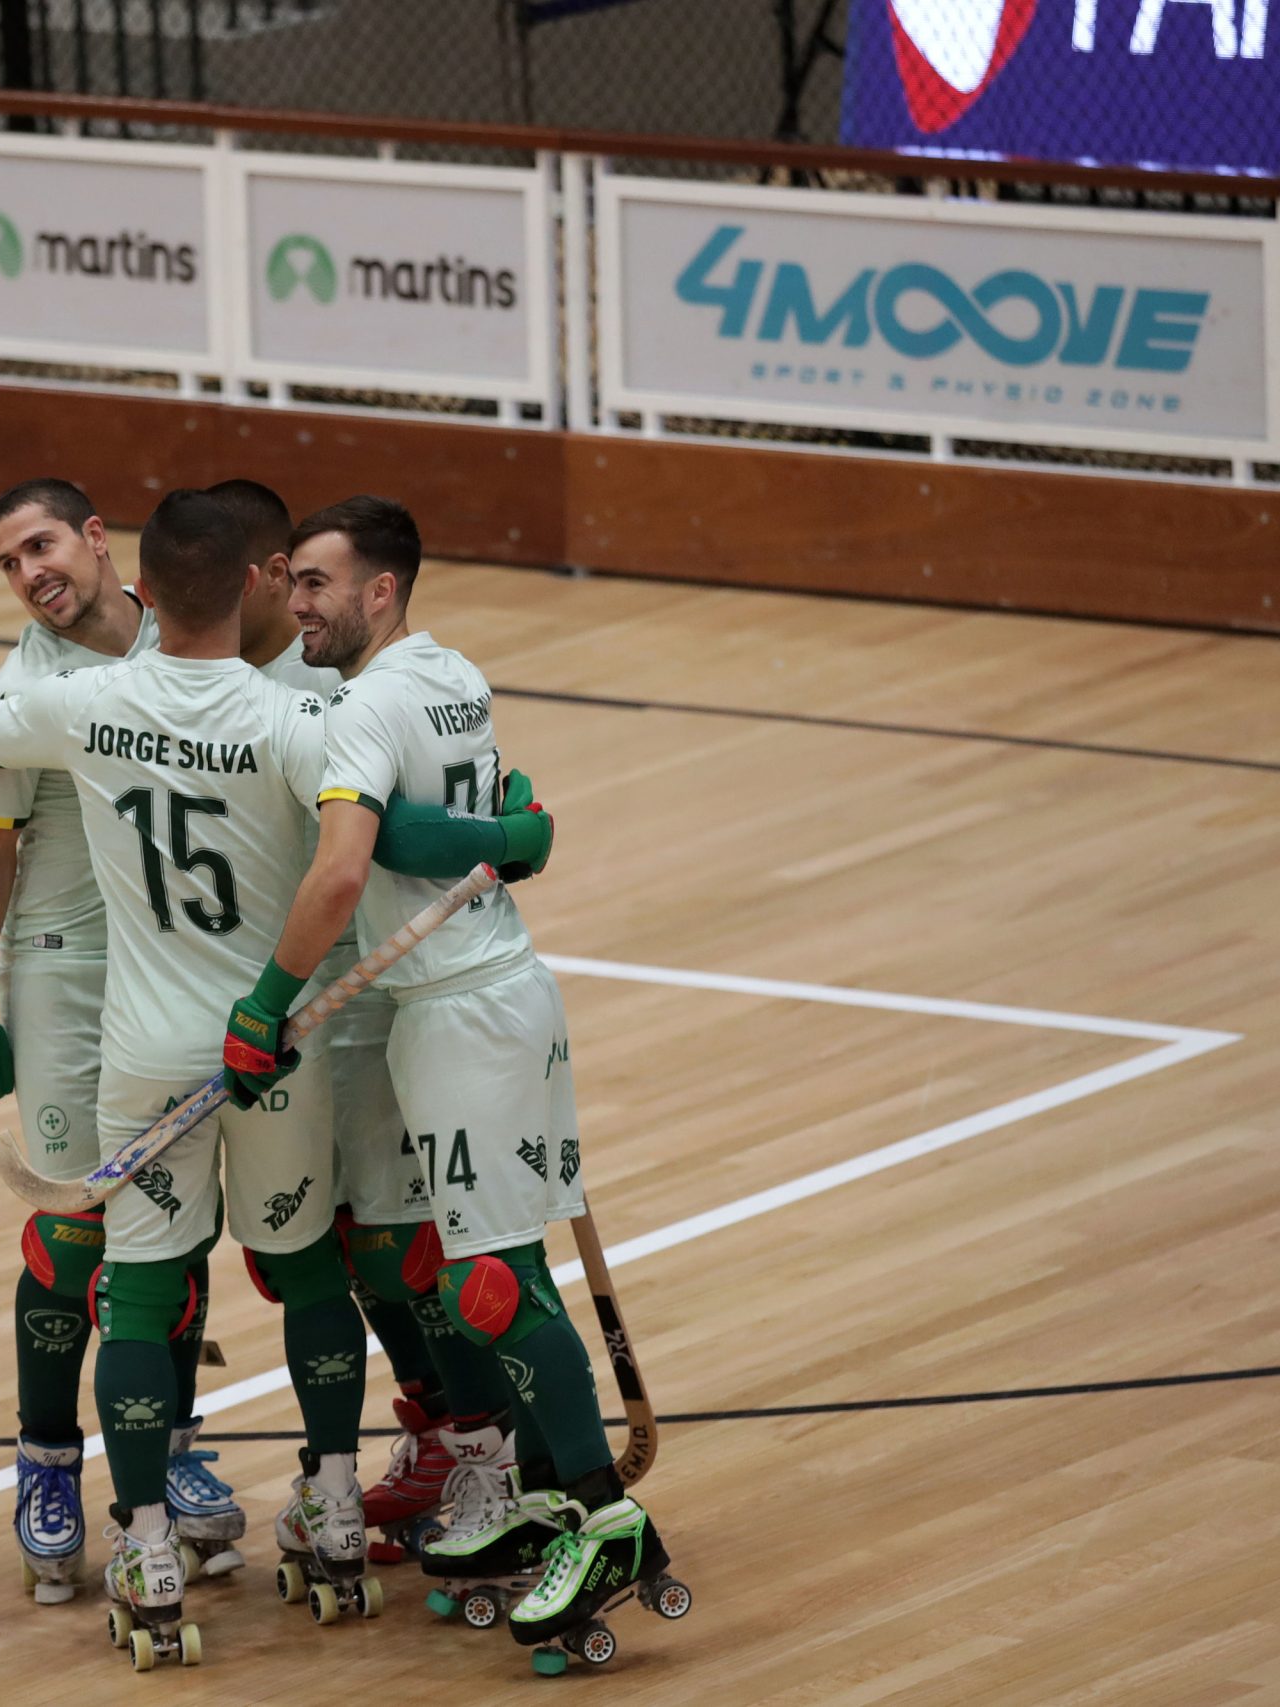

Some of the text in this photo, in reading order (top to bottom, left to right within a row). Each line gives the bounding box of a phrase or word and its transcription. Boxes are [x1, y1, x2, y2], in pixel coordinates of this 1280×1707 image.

[31, 229, 198, 283] martins
[349, 254, 518, 310] martins
[84, 722, 258, 774] JORGE SILVA
[114, 785, 244, 936] 15
[45, 1141, 69, 1154] FPP
[417, 1128, 477, 1197] 74
[33, 1339, 74, 1354] FPP
[307, 1371, 357, 1385] KELME
[114, 1419, 165, 1432] KELME
[340, 1531, 362, 1551] JS
[152, 1576, 176, 1595] JS
